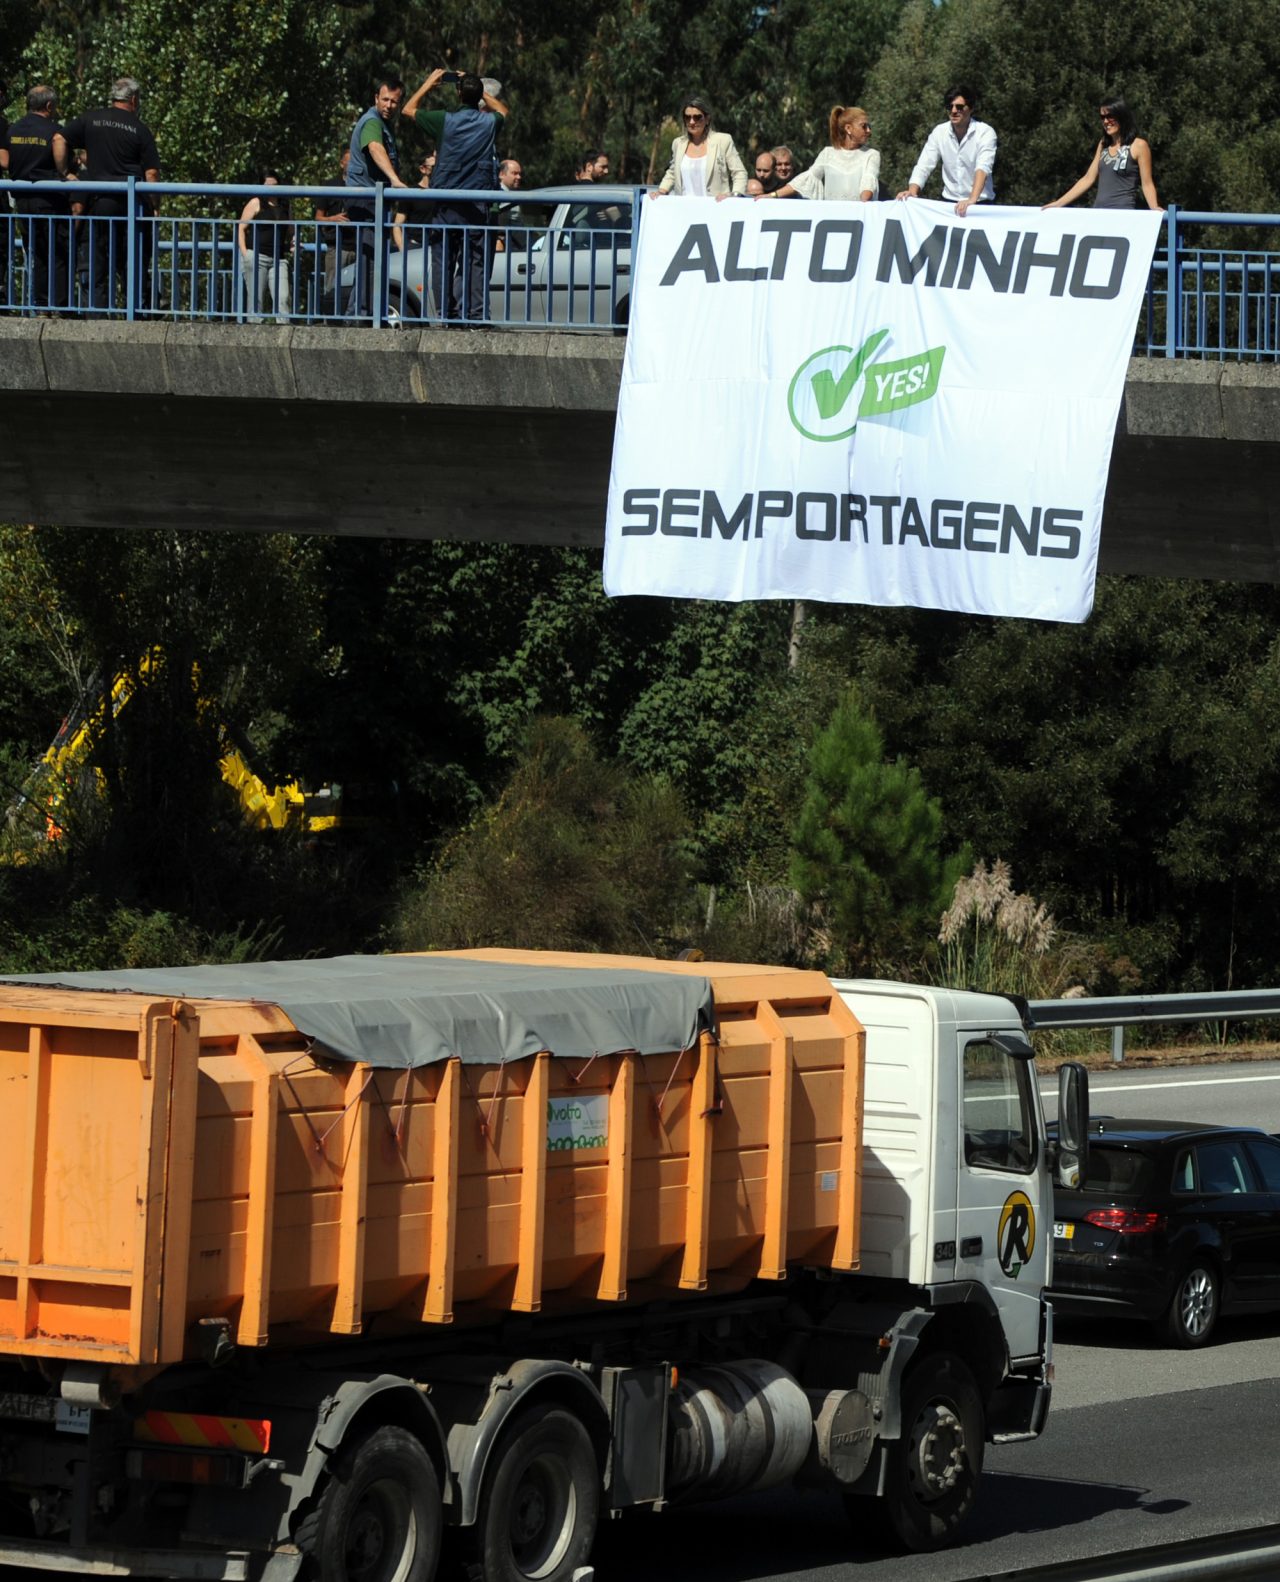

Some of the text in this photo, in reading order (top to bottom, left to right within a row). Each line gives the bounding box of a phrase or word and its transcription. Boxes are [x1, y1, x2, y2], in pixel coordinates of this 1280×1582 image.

[660, 219, 1131, 300] ALTO MINHO
[874, 361, 931, 402] YES!
[935, 1243, 955, 1259] 340
[1002, 1204, 1029, 1269] R
